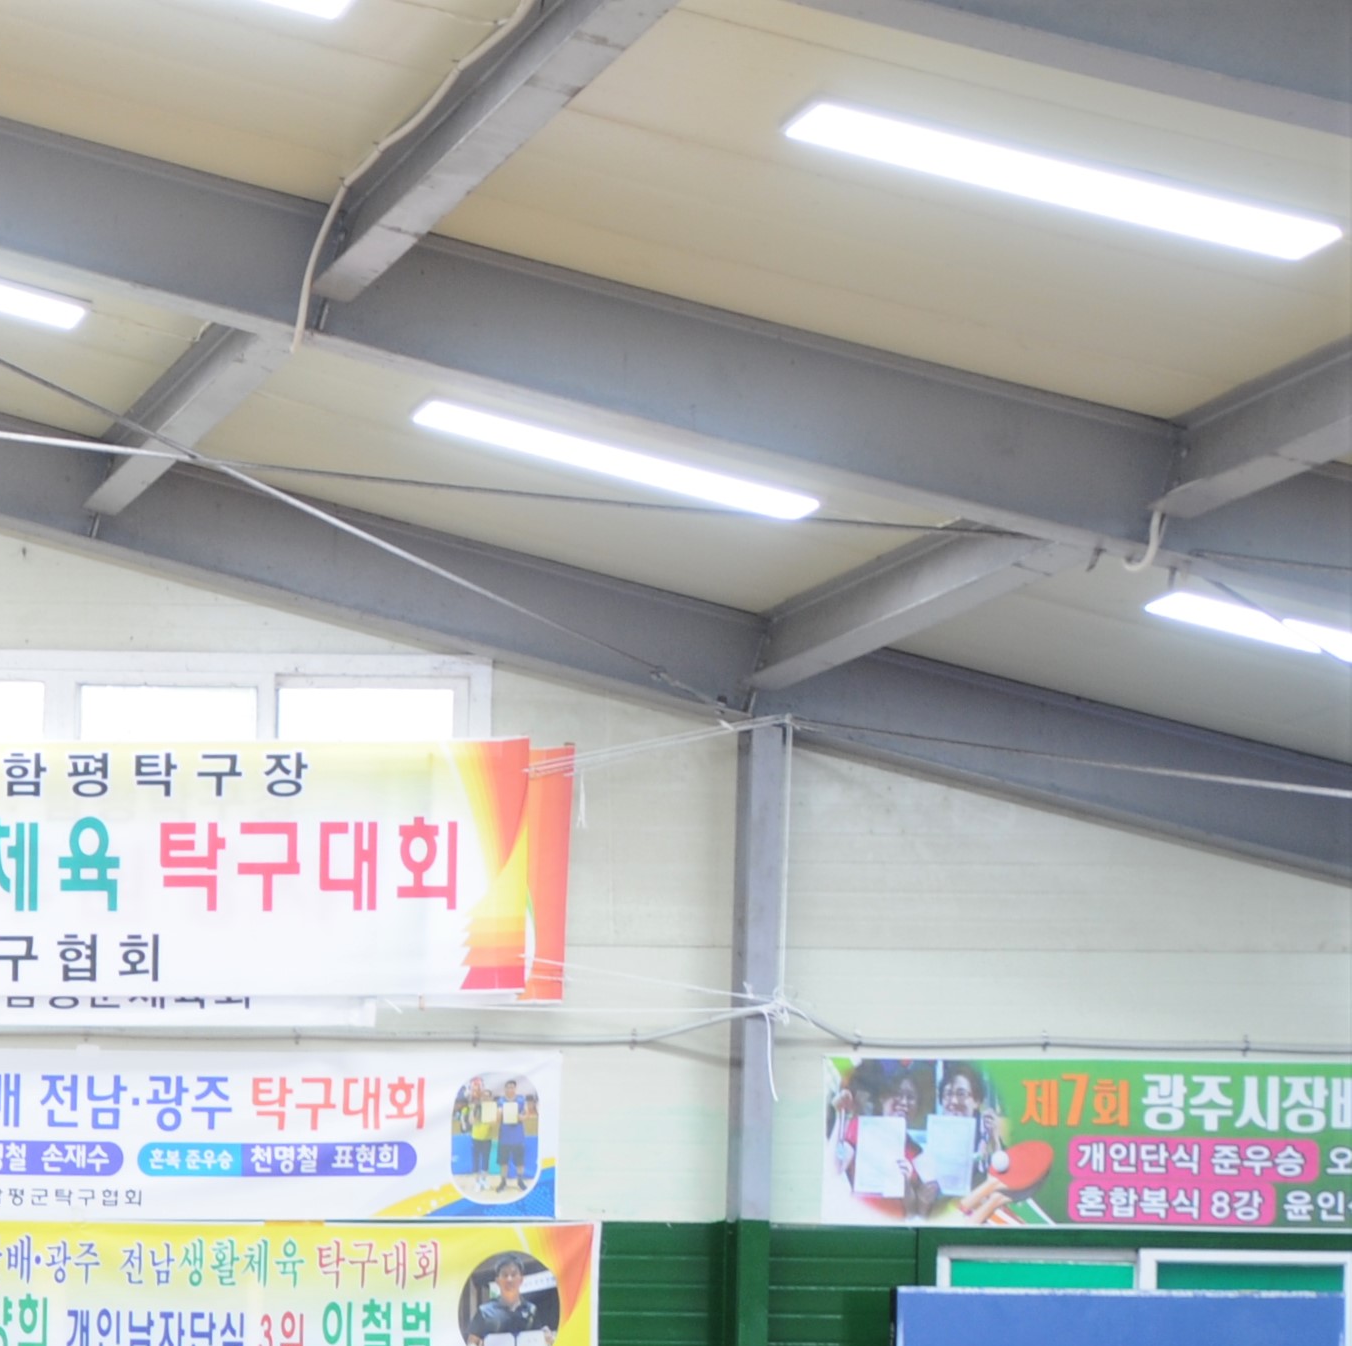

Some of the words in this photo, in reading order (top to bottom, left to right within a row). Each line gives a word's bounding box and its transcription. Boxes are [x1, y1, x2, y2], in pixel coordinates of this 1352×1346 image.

[159, 816, 459, 912] 탁구대회
[251, 1075, 427, 1131] 탁구대회
[1021, 1072, 1131, 1128] 제7회
[40, 1143, 111, 1173] 손재수
[250, 1144, 319, 1174] 천명철
[1077, 1142, 1200, 1175] 개인단식
[1210, 1144, 1306, 1177] 준우승
[1076, 1186, 1200, 1220] 혼합복식
[1210, 1190, 1263, 1222] 8강
[1283, 1190, 1352, 1222] 윤인
[316, 1239, 440, 1289] 탁구대회
